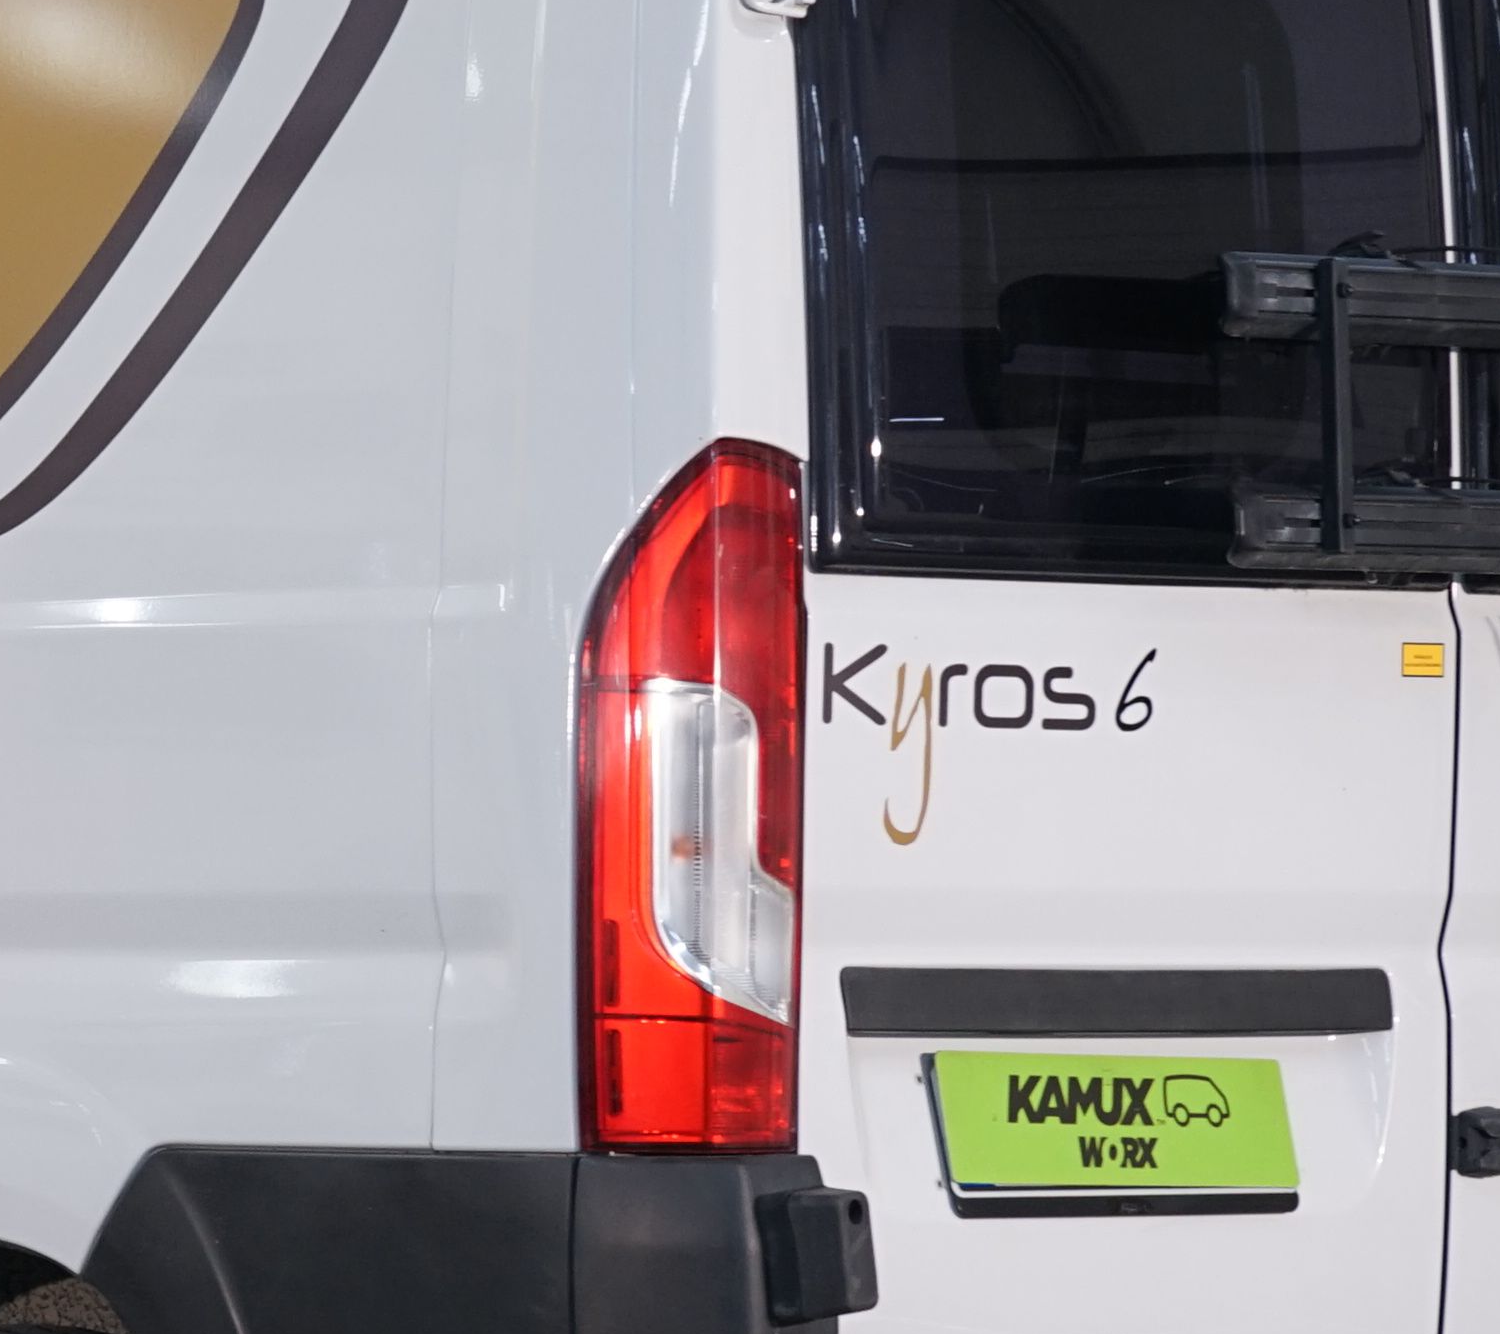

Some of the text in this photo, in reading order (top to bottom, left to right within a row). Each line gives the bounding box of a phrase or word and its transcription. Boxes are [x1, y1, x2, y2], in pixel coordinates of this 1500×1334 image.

[821, 641, 1158, 847] Kyros 6
[1007, 1074, 1155, 1126] KAMUX
